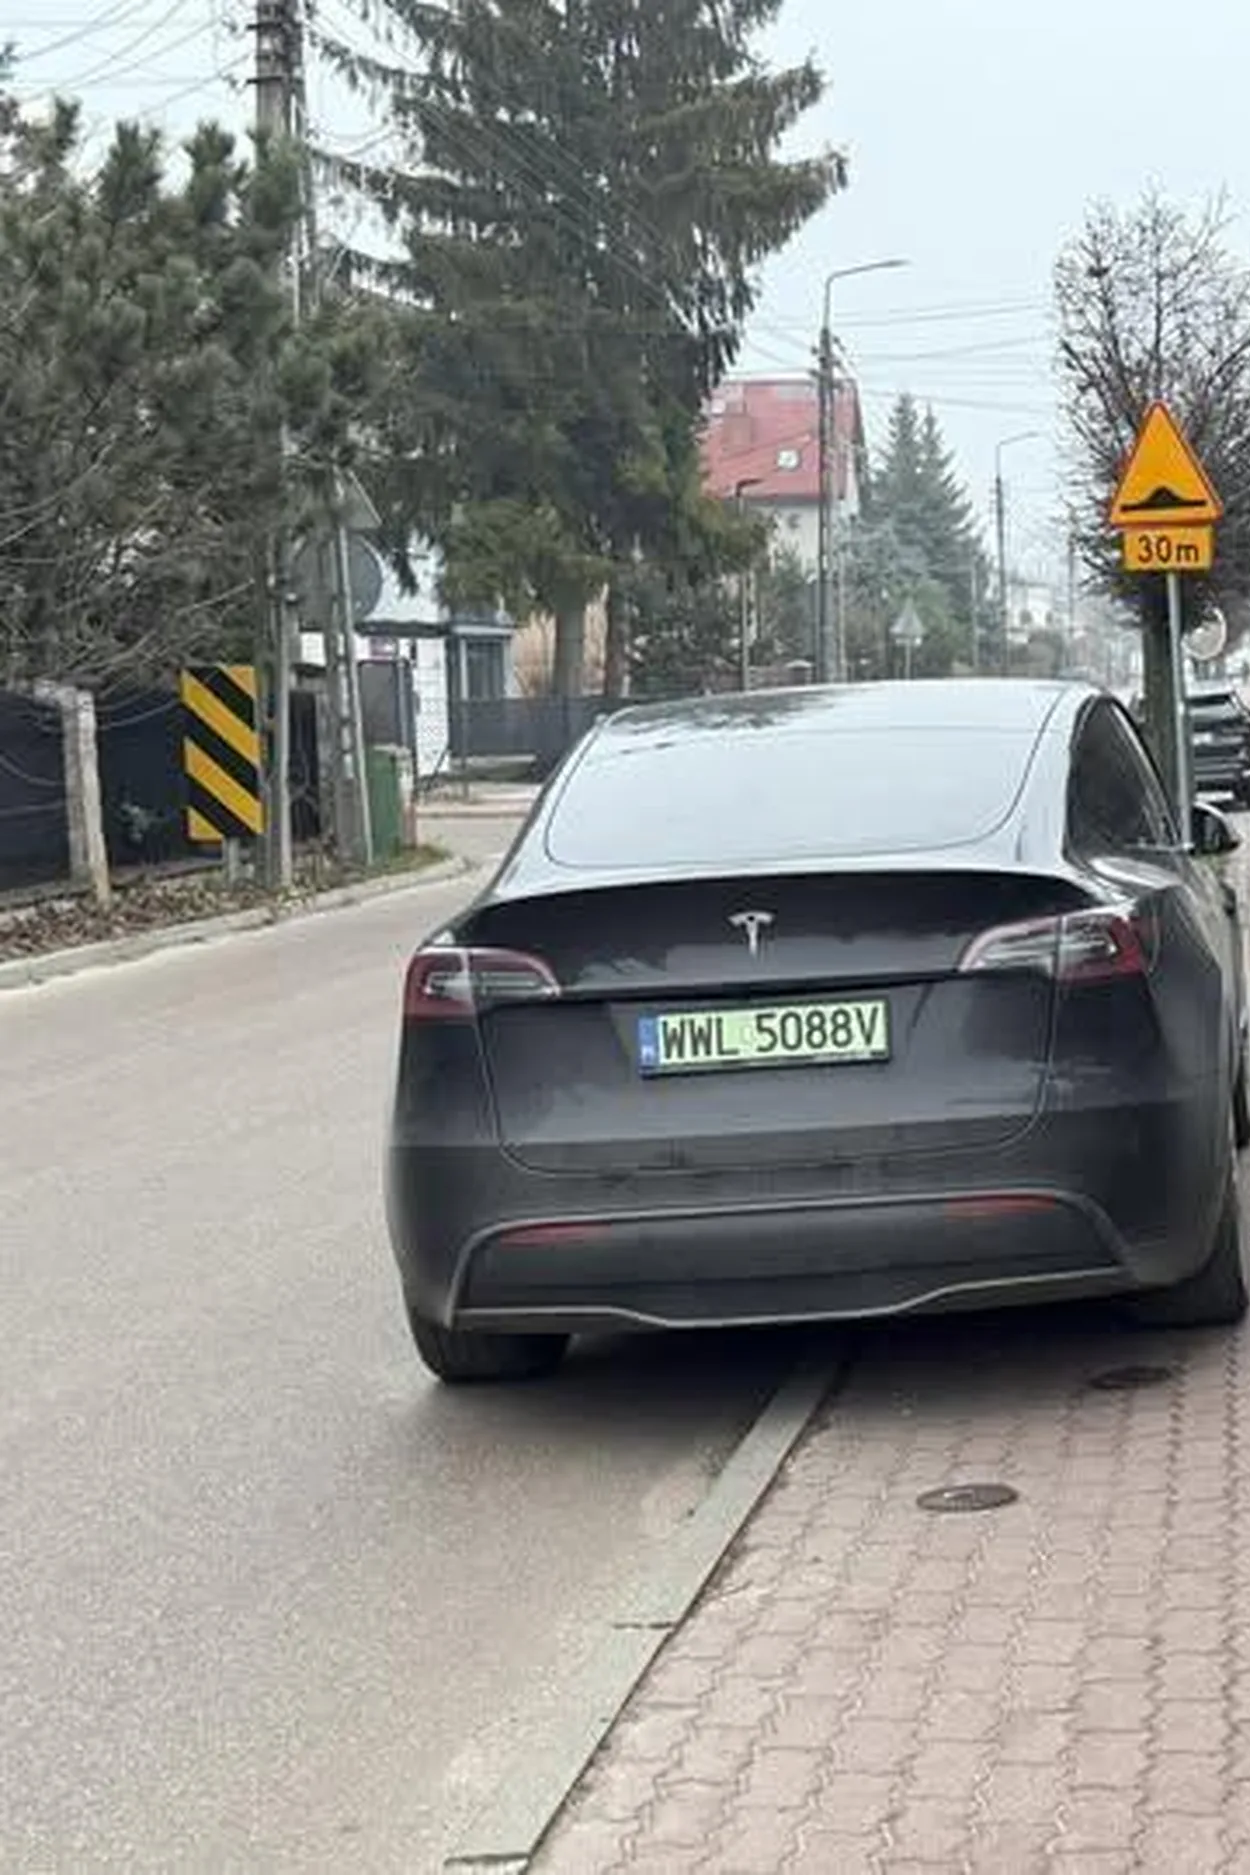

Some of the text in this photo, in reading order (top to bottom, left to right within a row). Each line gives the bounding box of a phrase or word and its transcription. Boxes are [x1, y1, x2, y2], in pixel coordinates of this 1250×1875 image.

[1137, 534, 1199, 563] 30m
[661, 1016, 739, 1059] WWL
[755, 1006, 879, 1052] 5088V
